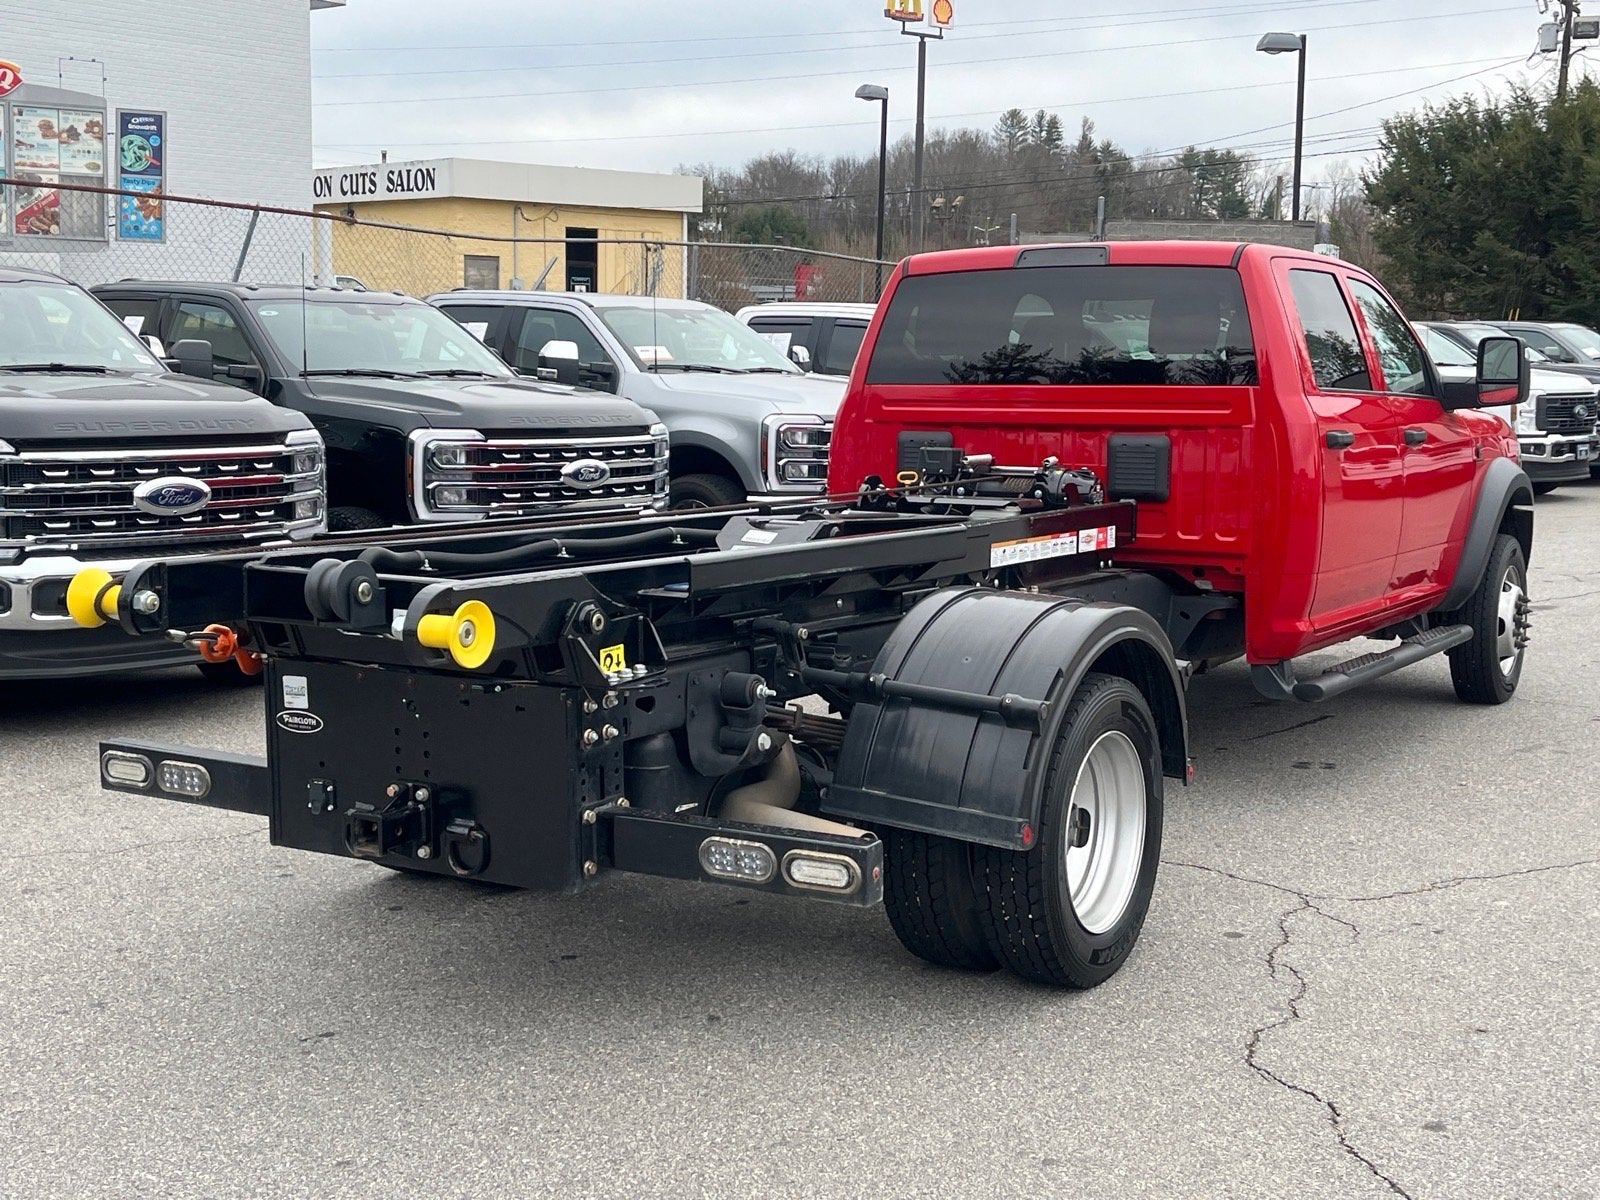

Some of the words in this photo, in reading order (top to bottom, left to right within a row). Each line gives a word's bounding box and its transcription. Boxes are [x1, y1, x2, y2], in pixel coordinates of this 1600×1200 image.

[313, 175, 332, 198] ON
[340, 172, 377, 196] CUTS
[386, 168, 436, 193] SALON
[53, 420, 166, 433] SUPER
[176, 416, 256, 431] DUTY
[508, 415, 584, 426] SUPER
[588, 414, 633, 424] DUTY
[578, 467, 601, 481] Ford
[157, 486, 193, 508] Ford
[283, 714, 316, 725] FAIRCLOTH
